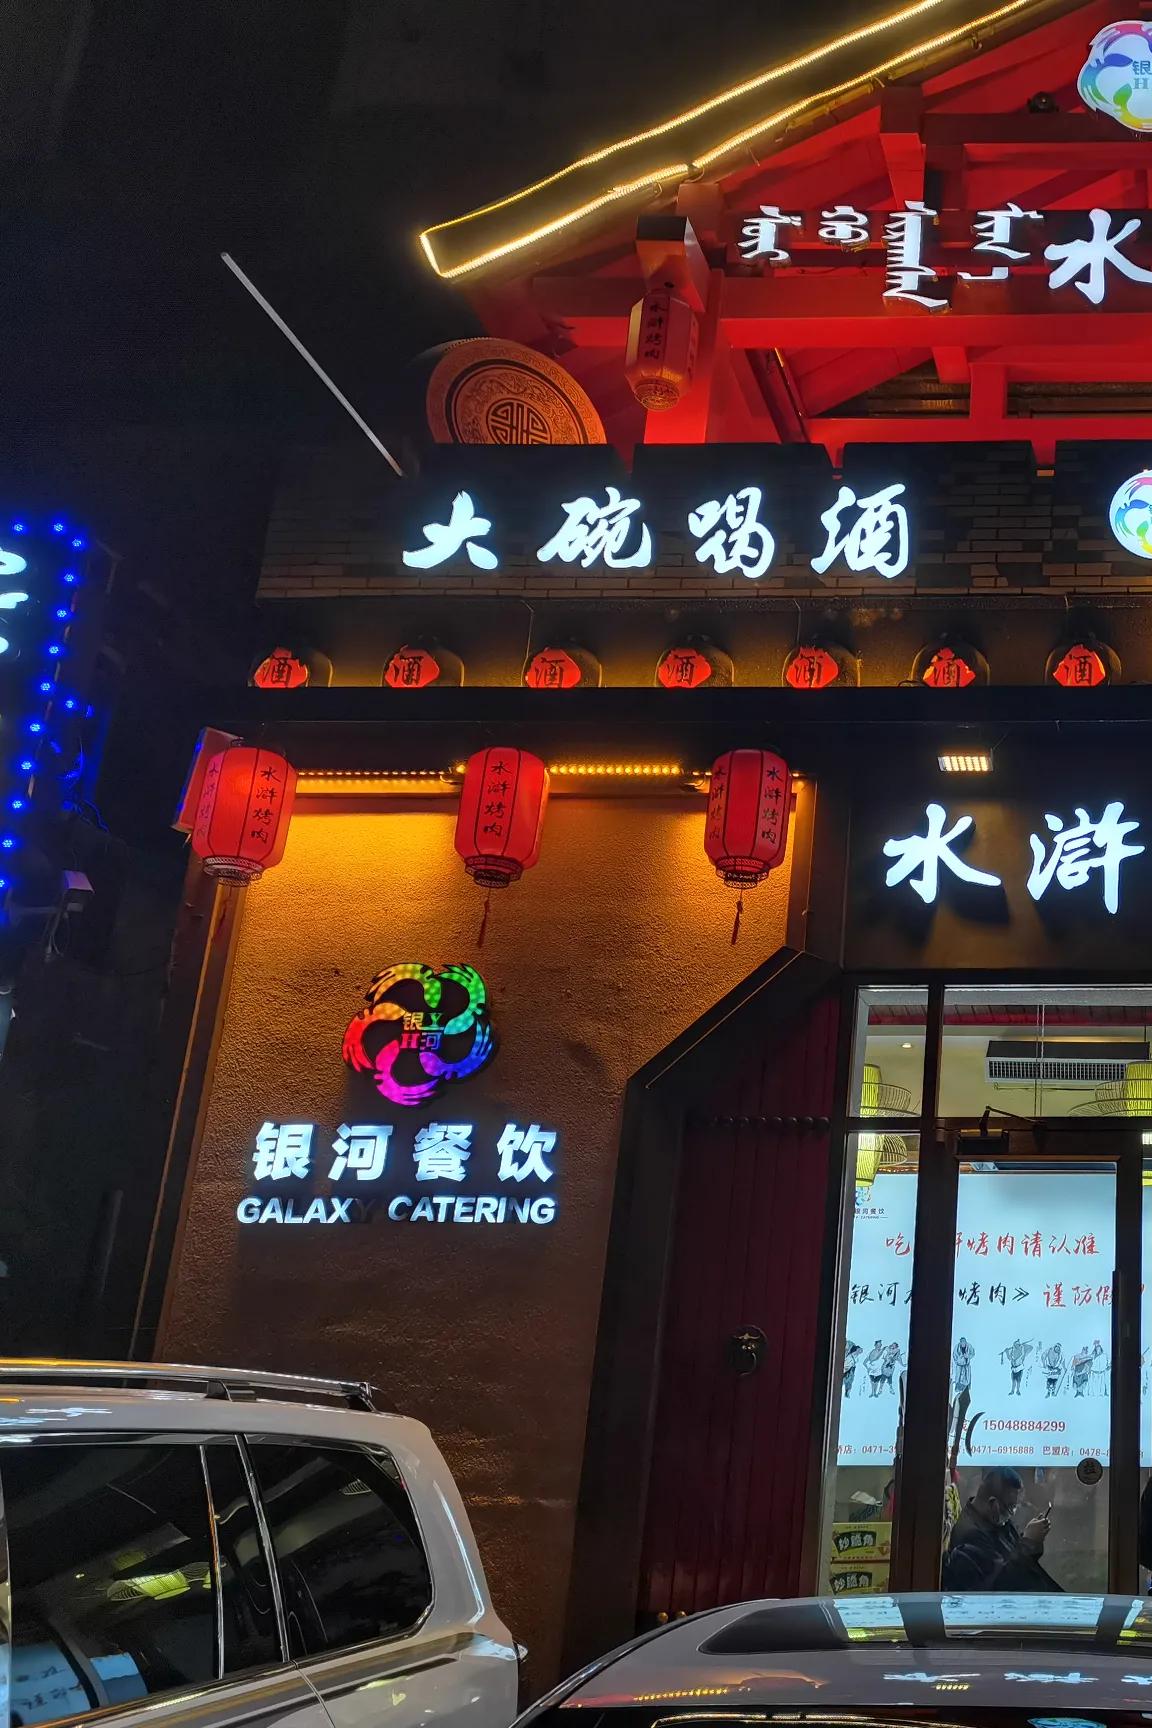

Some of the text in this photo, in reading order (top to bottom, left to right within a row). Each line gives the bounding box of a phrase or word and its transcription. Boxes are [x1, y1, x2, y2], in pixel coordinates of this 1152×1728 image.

[403, 484, 909, 579] 大碗喝酒
[263, 655, 292, 685] 酒
[392, 655, 423, 684] 酒
[535, 658, 564, 686] 酒
[667, 655, 695, 685] 酒
[795, 654, 823, 686] 酒
[934, 658, 961, 686] 酒
[1064, 655, 1092, 684] 酒
[252, 1121, 557, 1183] 银河餐饮
[236, 1196, 556, 1224] GALAXY CATERING
[982, 1420, 1066, 1433] 15048884299
